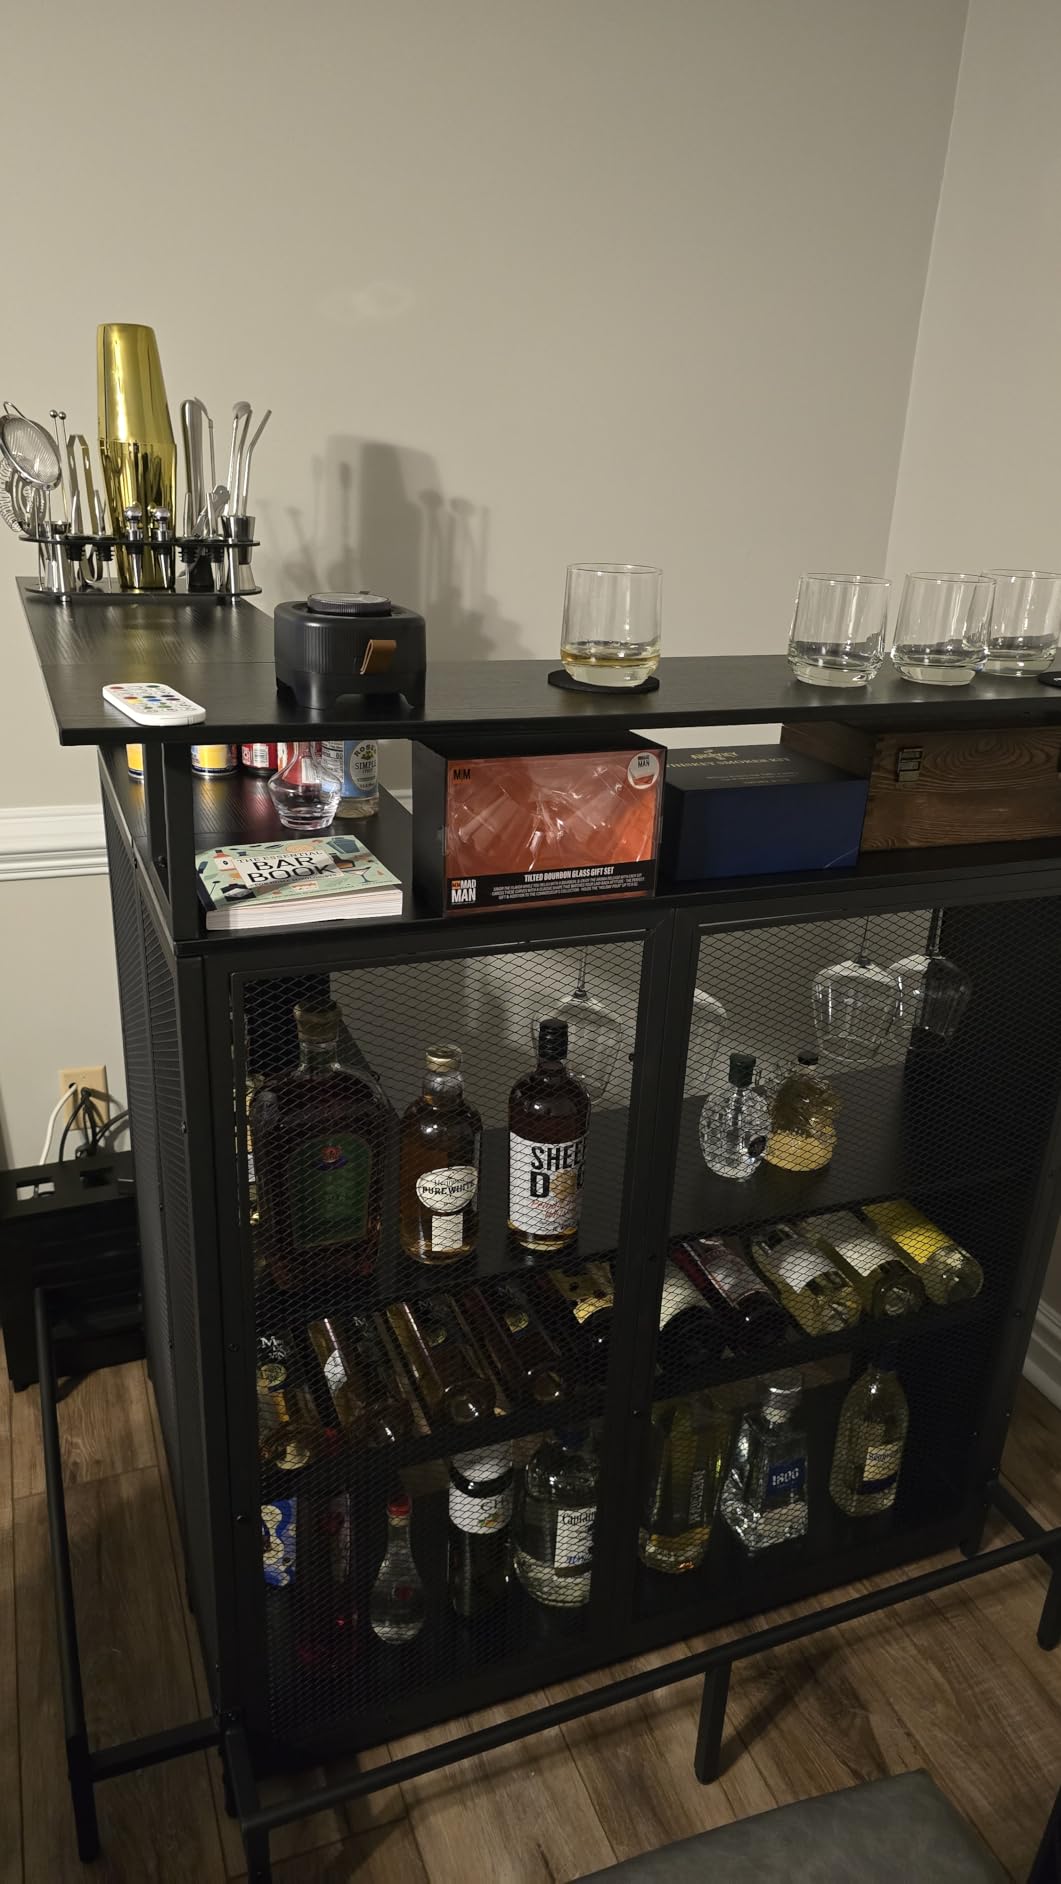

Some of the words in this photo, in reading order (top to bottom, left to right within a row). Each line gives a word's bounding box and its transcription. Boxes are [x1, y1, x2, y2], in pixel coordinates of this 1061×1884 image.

[252, 856, 317, 871] BAR
[247, 864, 336, 883] BOOK
[524, 873, 543, 882] TILTED
[544, 870, 571, 881] BOURBON
[572, 868, 590, 878] GLASS
[591, 867, 603, 876] GIFT
[604, 866, 615, 875] SET
[460, 878, 476, 888] MAD
[451, 887, 476, 902] MAN
[771, 1467, 800, 1486] 1800
